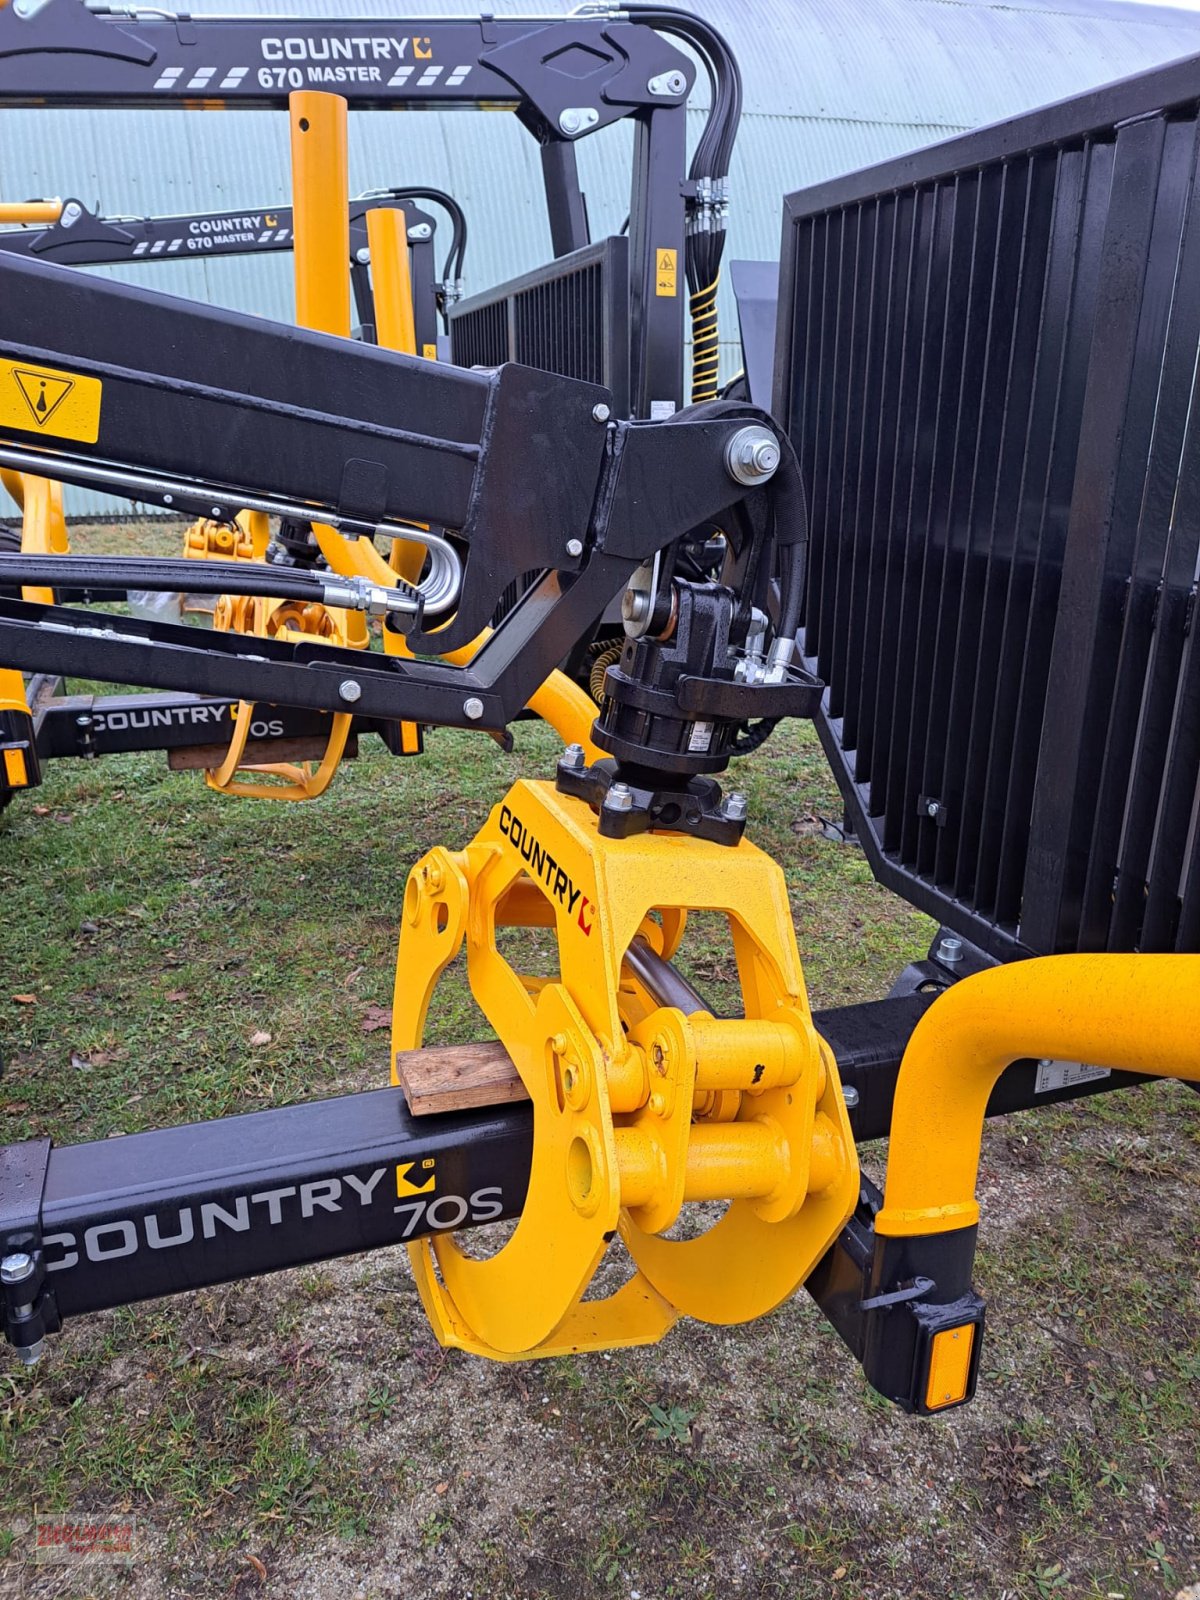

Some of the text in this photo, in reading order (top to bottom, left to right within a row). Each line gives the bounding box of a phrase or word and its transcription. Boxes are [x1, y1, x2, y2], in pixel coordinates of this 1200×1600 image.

[260, 37, 409, 61] COUNTRY
[257, 66, 382, 89] 670 MASTER
[189, 216, 262, 234] COUNTRY
[186, 232, 255, 250] 670 MASTER
[499, 804, 582, 915] COUNTRY
[42, 1168, 387, 1272] COUNTRY
[393, 1186, 504, 1238] 70S
